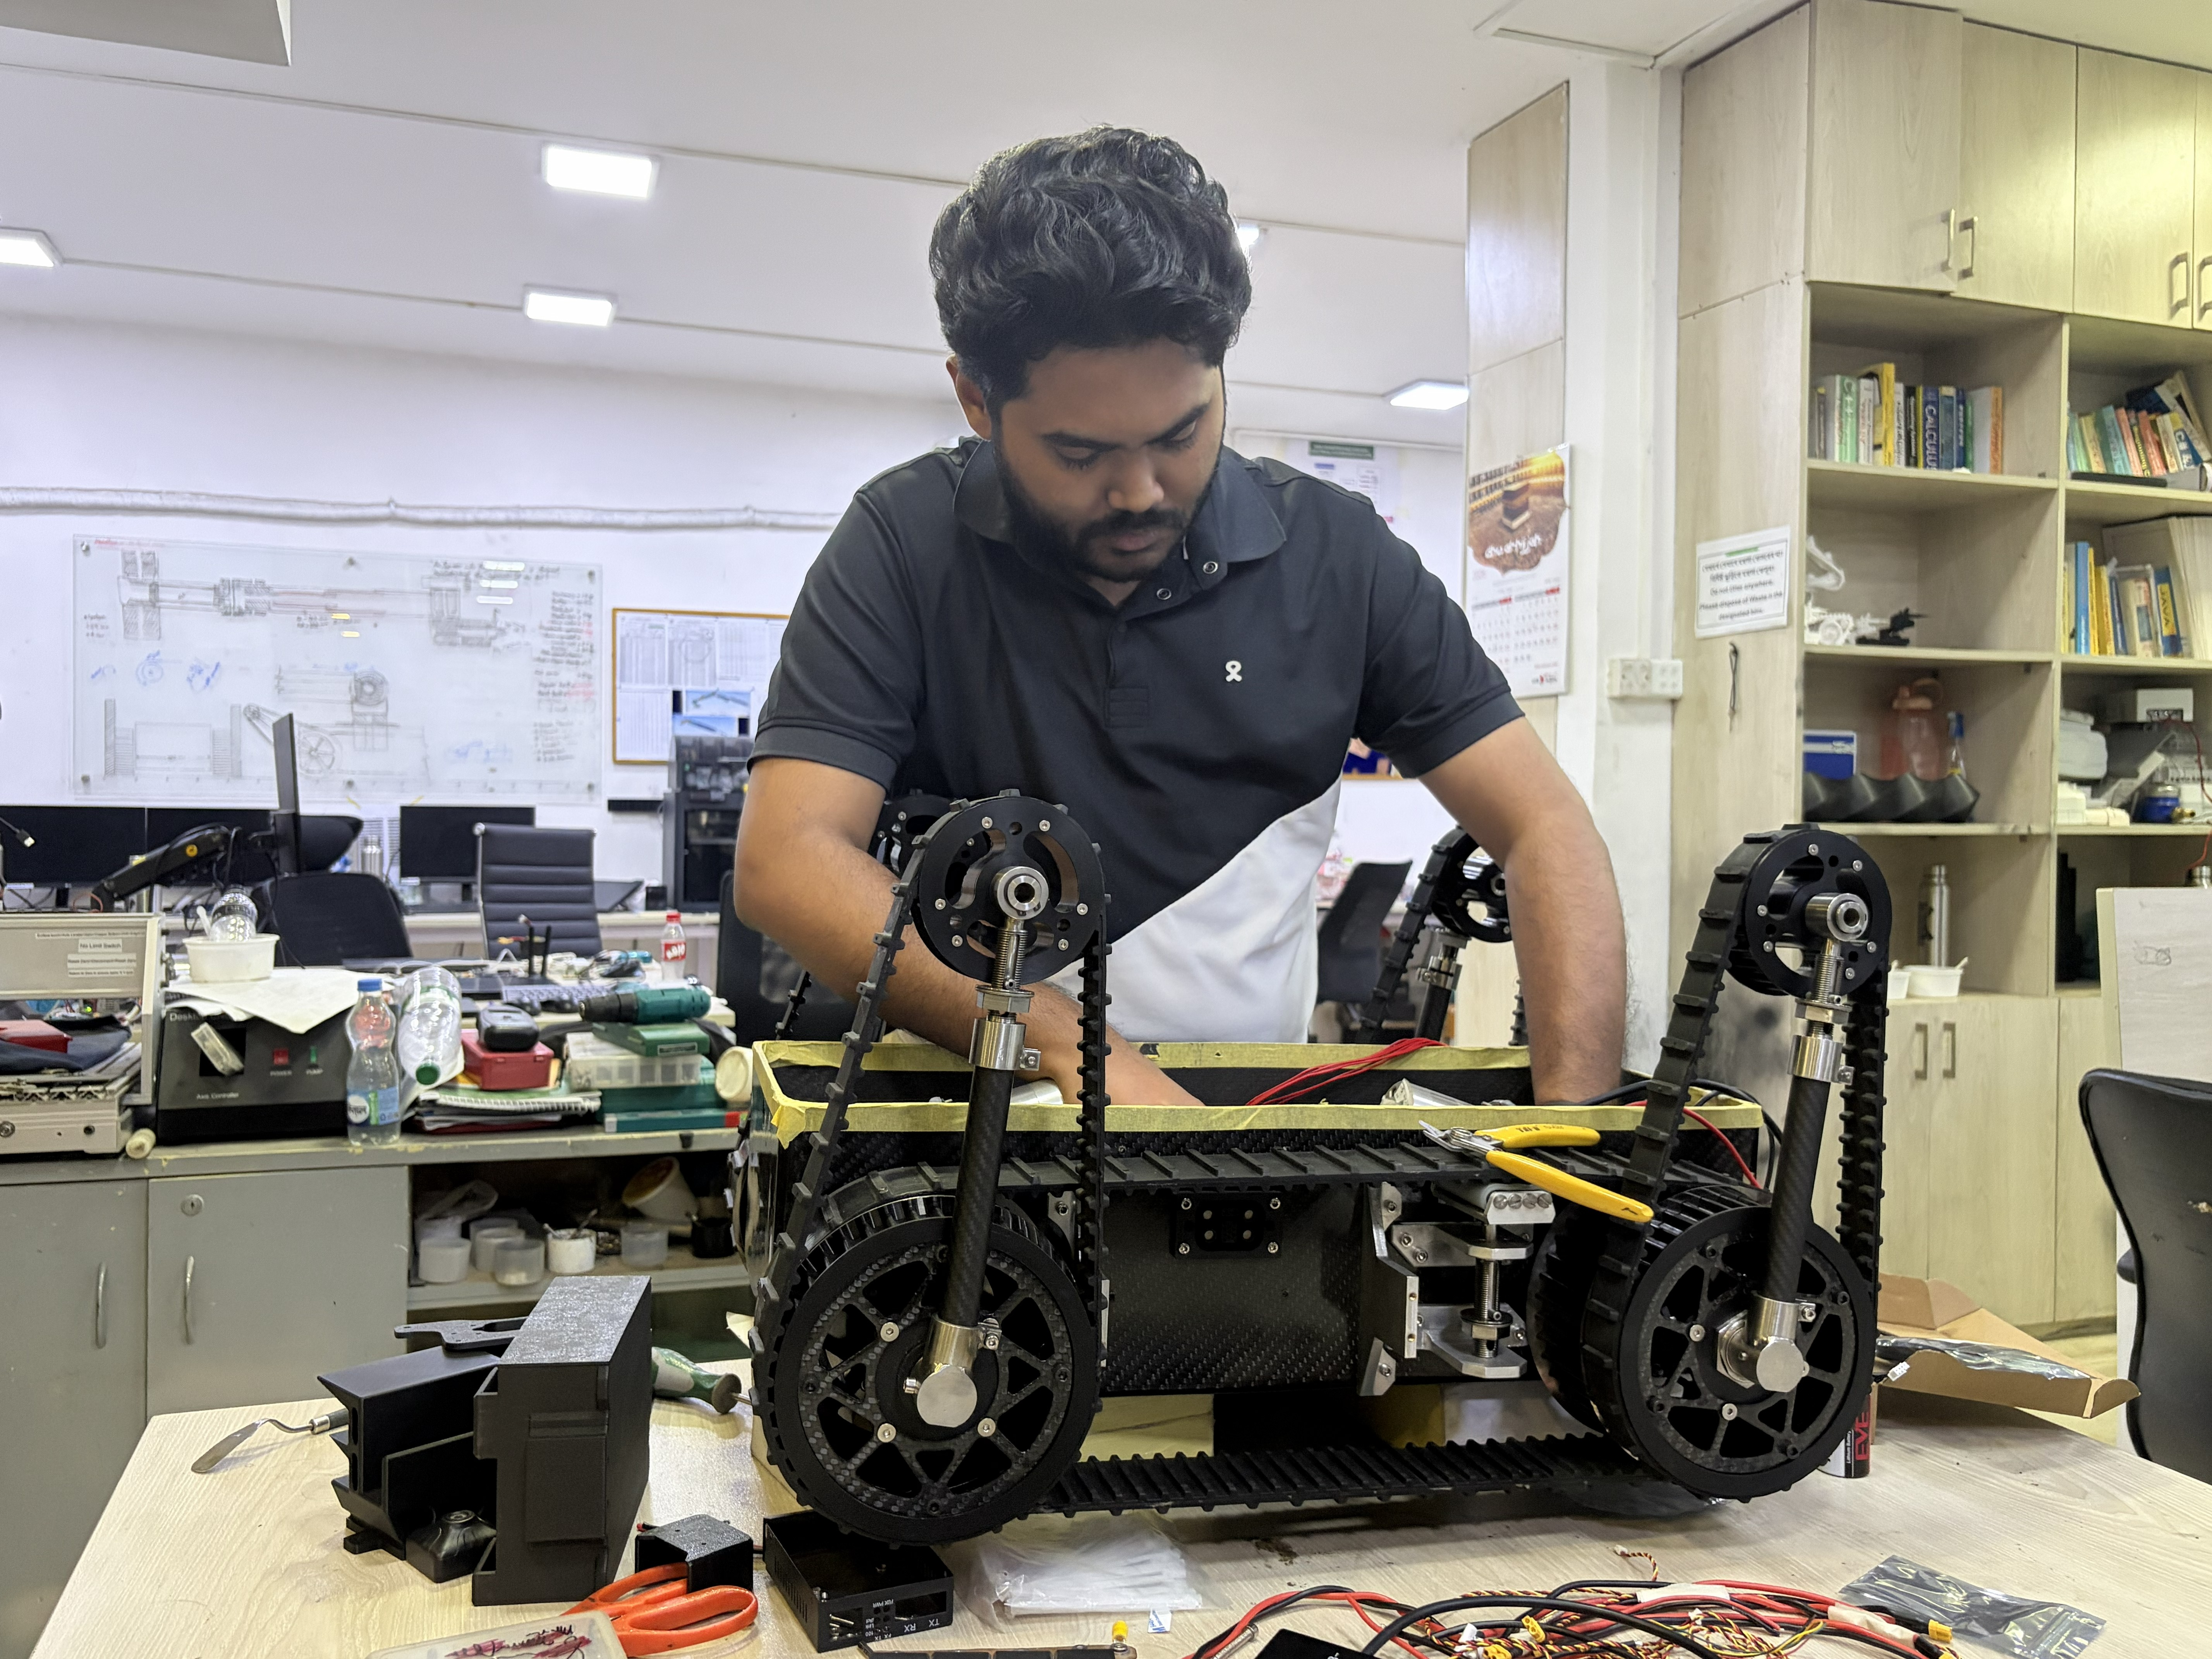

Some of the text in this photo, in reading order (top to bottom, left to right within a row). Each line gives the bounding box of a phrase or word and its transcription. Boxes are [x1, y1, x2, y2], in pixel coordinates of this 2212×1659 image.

[1855, 1412, 1870, 1460] EVE
[904, 1618, 939, 1632] TX RX
